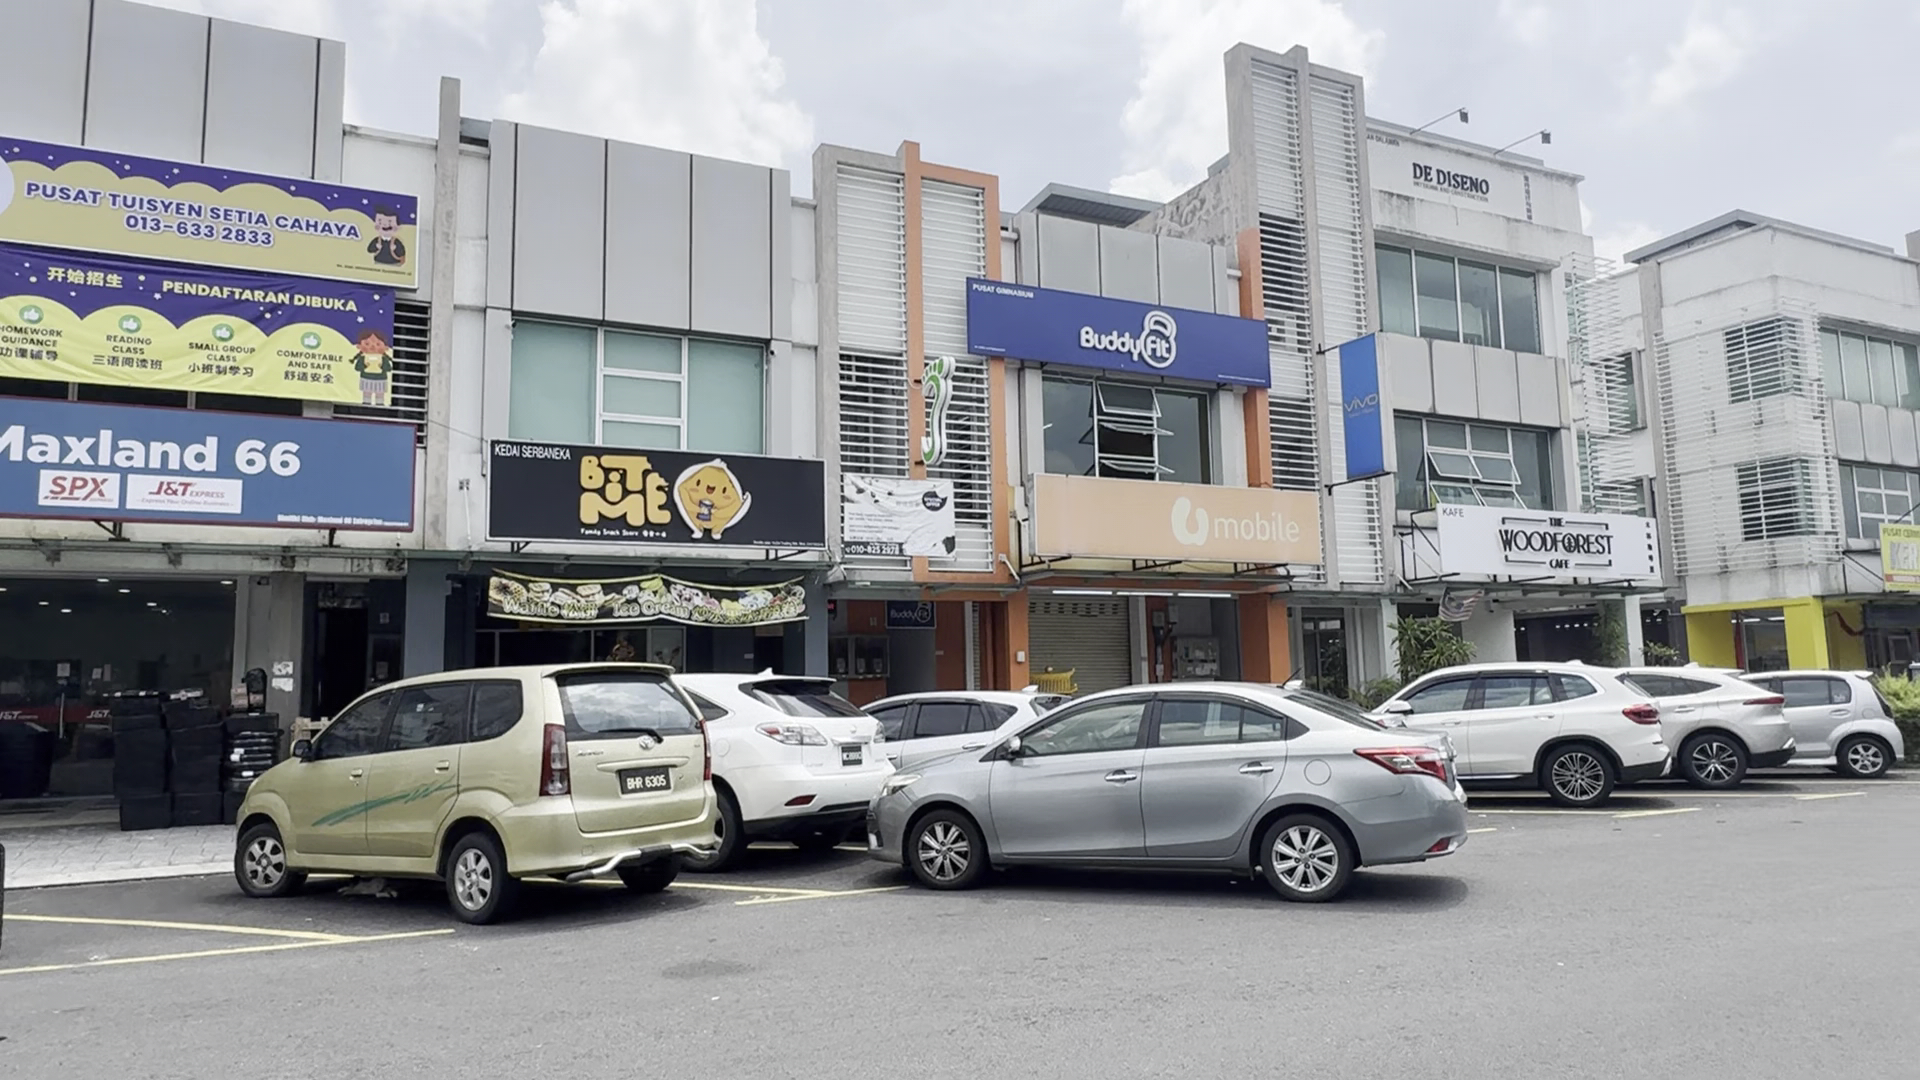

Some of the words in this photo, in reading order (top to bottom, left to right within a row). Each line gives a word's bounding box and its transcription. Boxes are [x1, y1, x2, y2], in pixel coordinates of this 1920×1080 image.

[1412, 162, 1433, 182] DE
[1436, 169, 1490, 195] DISENO
[26, 182, 101, 205] PUSAT
[108, 193, 202, 218] TUISYEN
[209, 206, 269, 227] SETIA
[275, 215, 360, 239] CAHAYA
[126, 214, 215, 239] 013-633
[221, 226, 273, 245] 2833
[47, 267, 123, 289] 开始招生
[162, 280, 289, 305] PENDAFTARAN
[293, 294, 358, 312] DIBUKA
[972, 283, 995, 293] PUSAT
[995, 286, 1035, 299] GIMNASIUM
[1, 335, 58, 348] GUIDANCE
[106, 334, 153, 346] READING
[1080, 326, 1141, 362] Buddy
[0, 346, 59, 362] 功课辅导
[112, 345, 145, 355] CLASS
[188, 342, 220, 352] SMALL
[222, 345, 256, 355] GROUP
[276, 349, 343, 363] COMFORTABLE
[92, 354, 163, 370] 三语阅读班
[206, 353, 237, 363] CLASS
[287, 360, 308, 370] AND
[310, 362, 332, 371] SAFE
[188, 362, 254, 378] 小班制学习
[283, 370, 335, 384] 舒适安全
[235, 439, 301, 477] 66
[494, 443, 520, 458] KEDAI
[521, 446, 572, 461] SERBANEKA
[49, 476, 109, 501] SPX
[149, 480, 198, 497] J&T
[189, 490, 225, 499] EXPRESS
[1442, 507, 1465, 518] KAFE
[1213, 511, 1301, 543] mobile
[1549, 517, 1565, 528] THE
[1882, 527, 1902, 537] PUSAT
[1499, 528, 1614, 555] WOODFOREST
[1549, 558, 1571, 569] CAFE
[503, 598, 560, 618] Waffle
[611, 601, 641, 617] Ice
[640, 599, 690, 620] Cream
[86, 709, 111, 719] J&T
[626, 776, 644, 790] BHR
[645, 774, 667, 788] 6305
